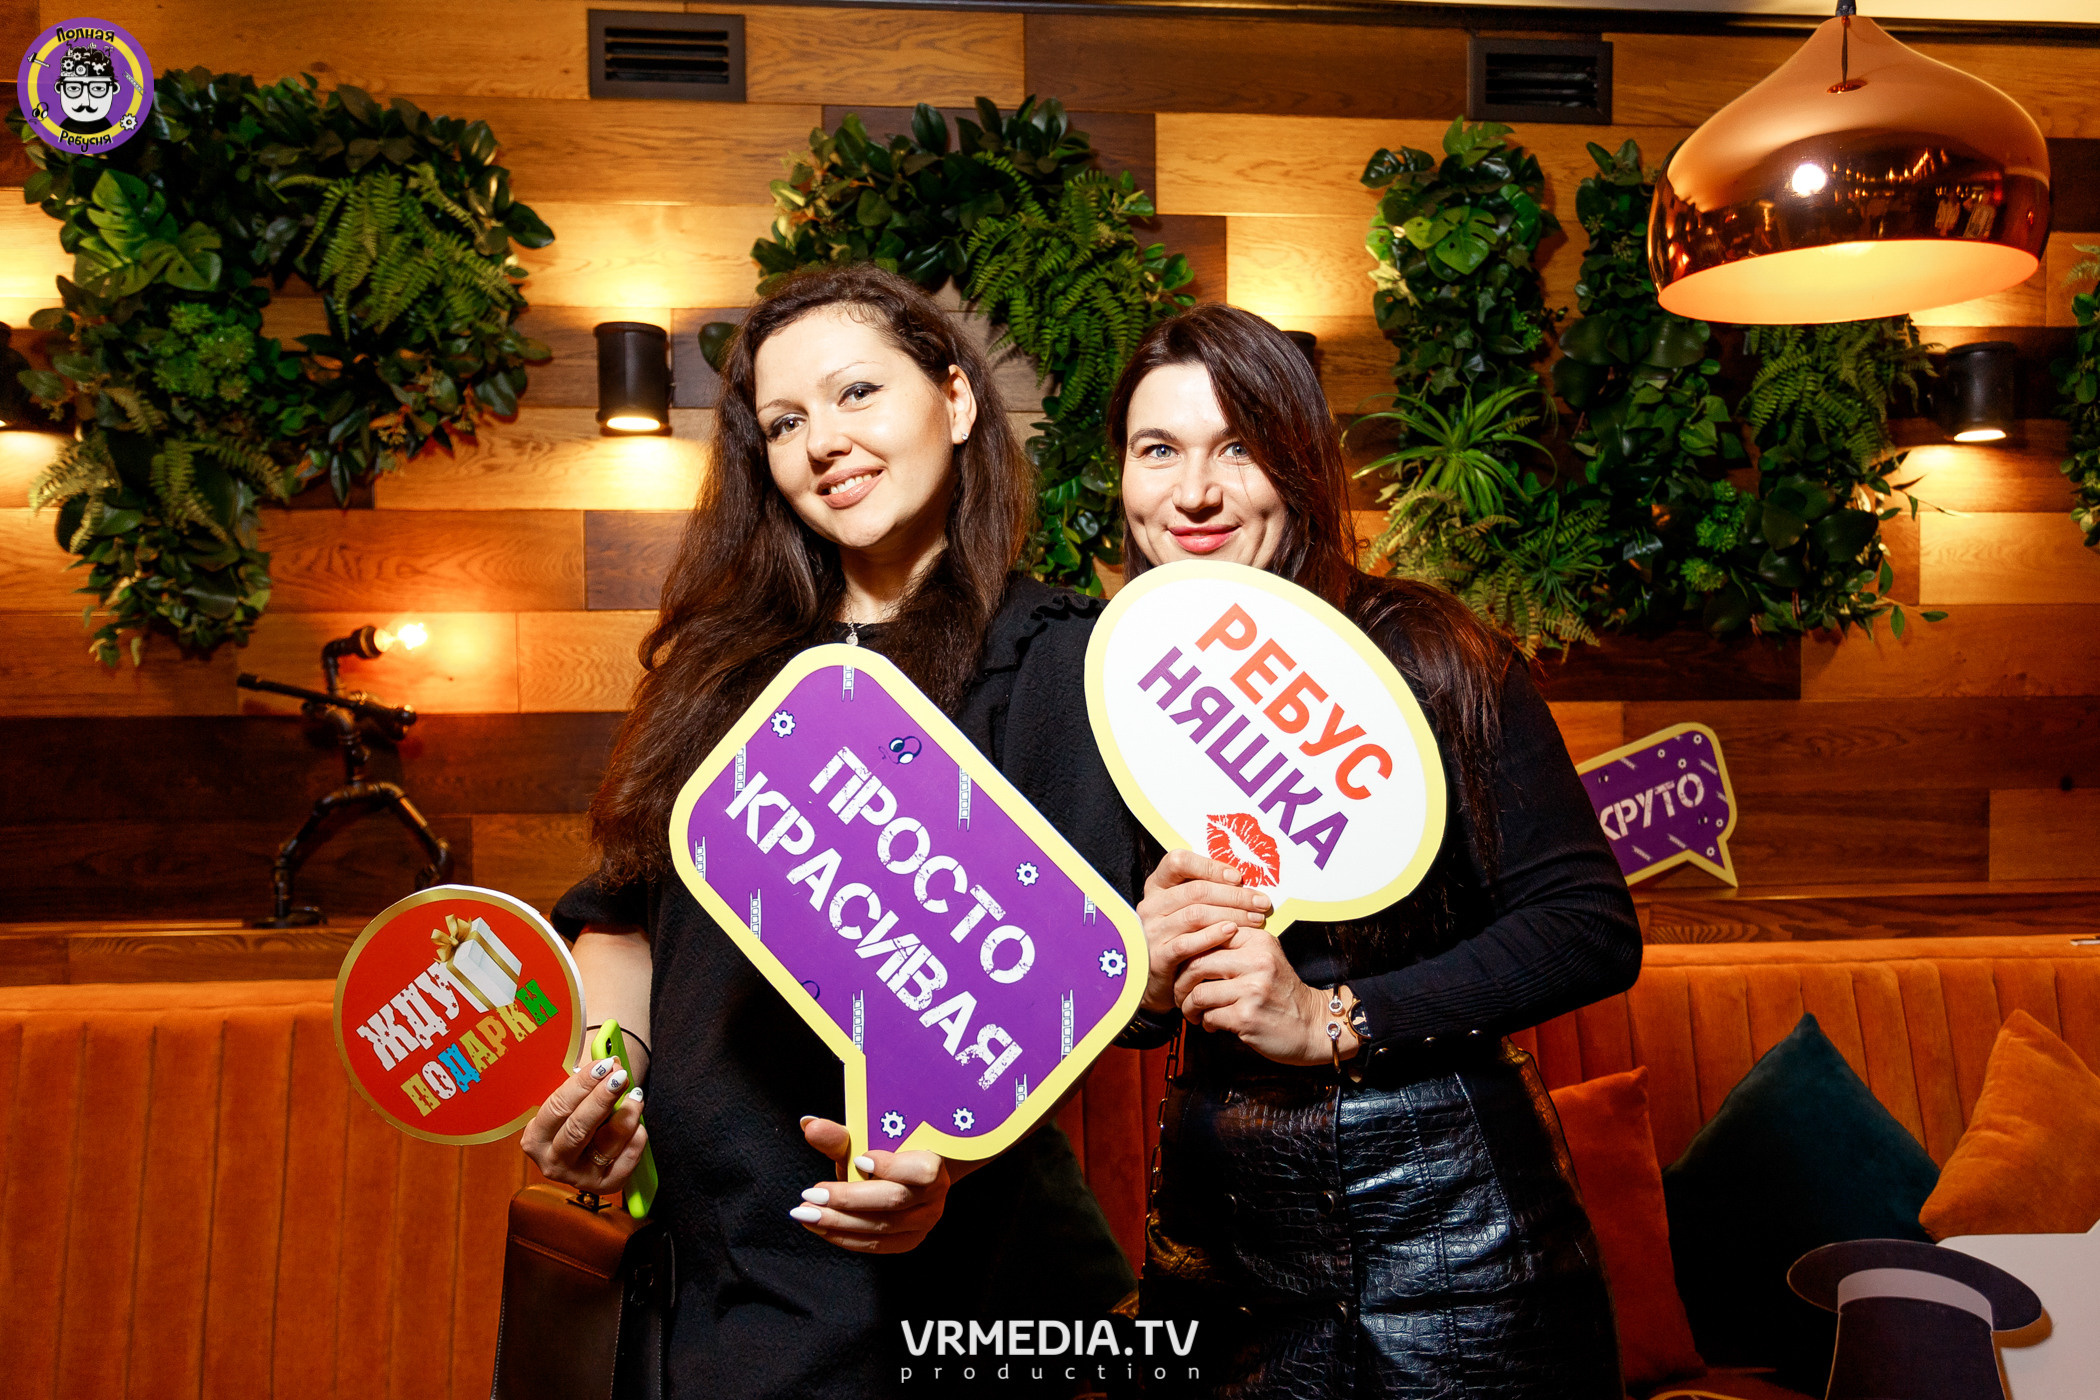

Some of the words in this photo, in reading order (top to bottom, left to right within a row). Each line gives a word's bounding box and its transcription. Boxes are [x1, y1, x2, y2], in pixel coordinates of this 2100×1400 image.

[1137, 646, 1349, 871] НЯШКА
[1194, 603, 1393, 801] РЕБУС
[725, 771, 1023, 1090] КРАСИВАЯ
[808, 746, 1036, 984] ПРОСТО
[356, 961, 460, 1072] ЖДУ
[400, 979, 559, 1117] ПОДАРКИ
